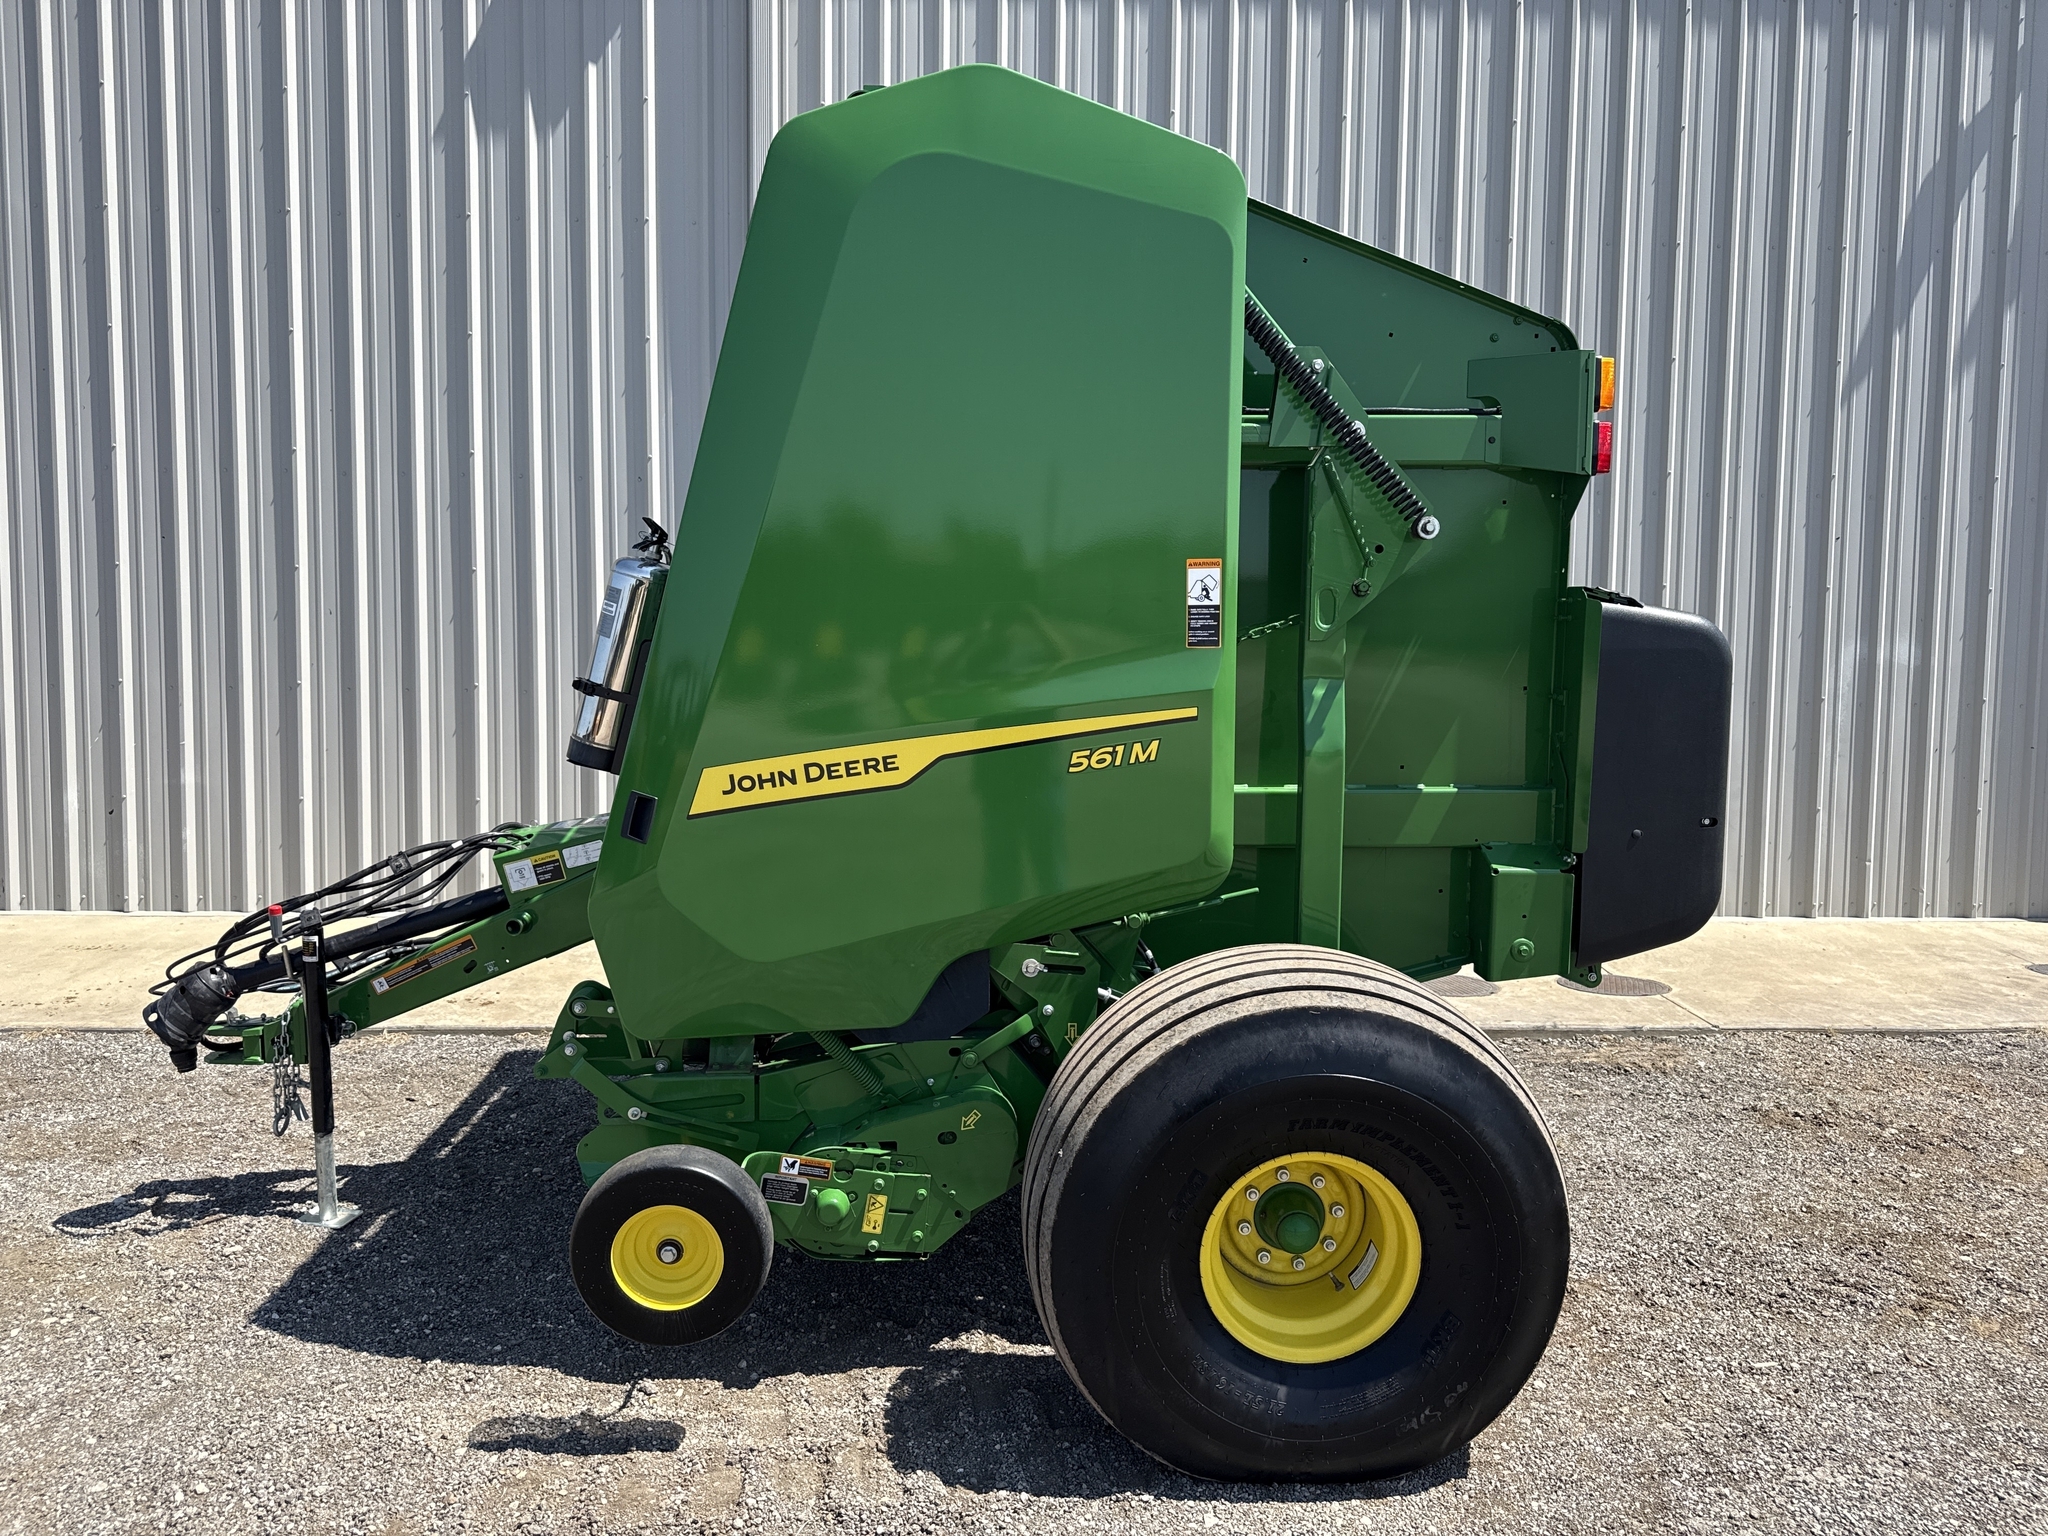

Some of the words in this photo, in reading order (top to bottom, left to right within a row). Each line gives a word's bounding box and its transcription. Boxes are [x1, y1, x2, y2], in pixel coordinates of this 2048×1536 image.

[722, 767, 797, 795] JOHN
[803, 754, 900, 783] DEERE
[1287, 1117, 1350, 1132] FARM
[1350, 1121, 1459, 1198] IMPLEMENT
